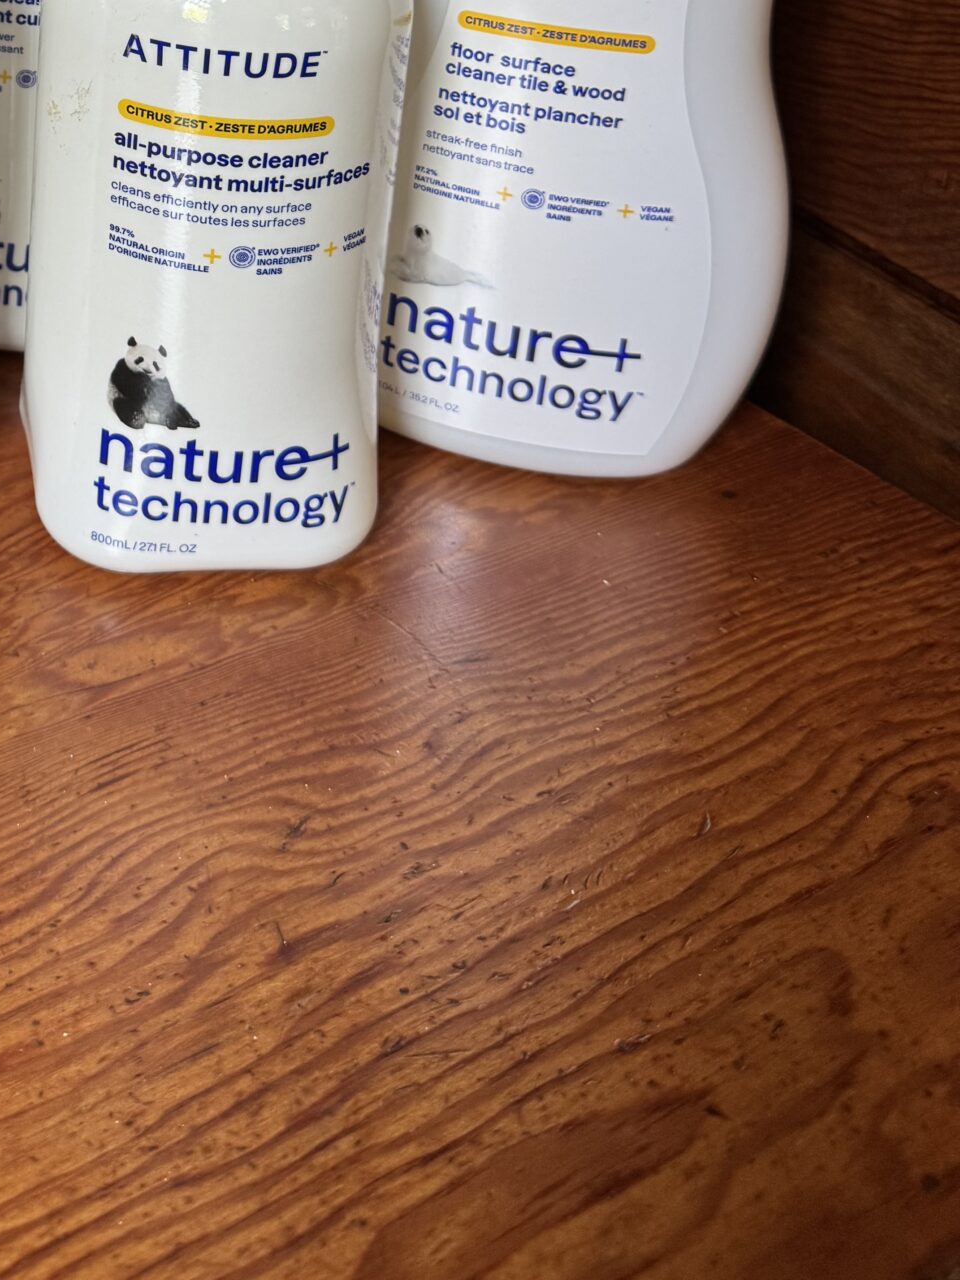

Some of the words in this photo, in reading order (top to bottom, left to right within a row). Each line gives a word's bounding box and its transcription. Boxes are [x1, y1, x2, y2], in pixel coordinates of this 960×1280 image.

[465, 15, 505, 31] CITRUS
[507, 23, 535, 35] ZEST
[542, 30, 577, 42] ZESTE
[579, 35, 647, 49] D'AGRUMES
[123, 33, 321, 79] ATTITUDE
[450, 42, 494, 63] floor
[500, 52, 576, 77] surface
[445, 62, 515, 86] cleaner
[518, 73, 549, 93] tile
[553, 81, 567, 95] &
[572, 85, 626, 102] wood
[126, 104, 172, 123] CITRUS
[174, 115, 207, 130] ZEST
[215, 122, 255, 134] ZESTE
[258, 121, 327, 134] D'AGRUMES
[433, 103, 460, 119] sol
[463, 109, 482, 125] et
[486, 114, 526, 134] bois
[438, 85, 530, 117] nettoyant
[533, 105, 623, 129] plancher
[114, 131, 244, 167] all-purpose
[248, 150, 329, 169] cleaner
[426, 128, 487, 152] streak-free
[490, 142, 522, 158] finish
[113, 153, 222, 191] nettoyant
[227, 161, 370, 193] multi-surfaces
[422, 143, 474, 163] nettoyant
[475, 156, 502, 168] sans
[504, 162, 534, 175] trace
[111, 180, 151, 200] cleans
[153, 191, 218, 214] efficiently
[221, 203, 237, 213] on
[240, 203, 263, 215] any
[266, 202, 312, 213] surface
[413, 183, 452, 199] D'ORIGINE
[453, 195, 500, 209] NATURELLE
[414, 174, 450, 189] NATURAL
[452, 184, 480, 196] ORIGIN
[110, 194, 160, 216] efficace
[163, 209, 183, 221] sur
[186, 212, 229, 225] toutes
[231, 216, 249, 227] les
[252, 216, 306, 228] surfaces
[546, 213, 571, 221] SAINS
[640, 213, 674, 222] VÉGANE
[110, 224, 135, 238] 99.7%
[343, 228, 365, 241] VEGAN
[343, 236, 366, 252] VÉGANE
[109, 233, 150, 252] NATURAL
[152, 247, 185, 260] ORIGIN
[109, 243, 153, 262] D'ORIGINE
[154, 257, 209, 273] NATURELLE
[257, 248, 278, 256] EWG
[257, 255, 312, 266] INGRÉDIENTS
[380, 335, 634, 421] technology
[444, 402, 460, 412] OZ
[93, 476, 349, 528] technology
[90, 531, 131, 550] 800mL
[159, 542, 176, 552] FL.
[179, 544, 197, 553] OZ
